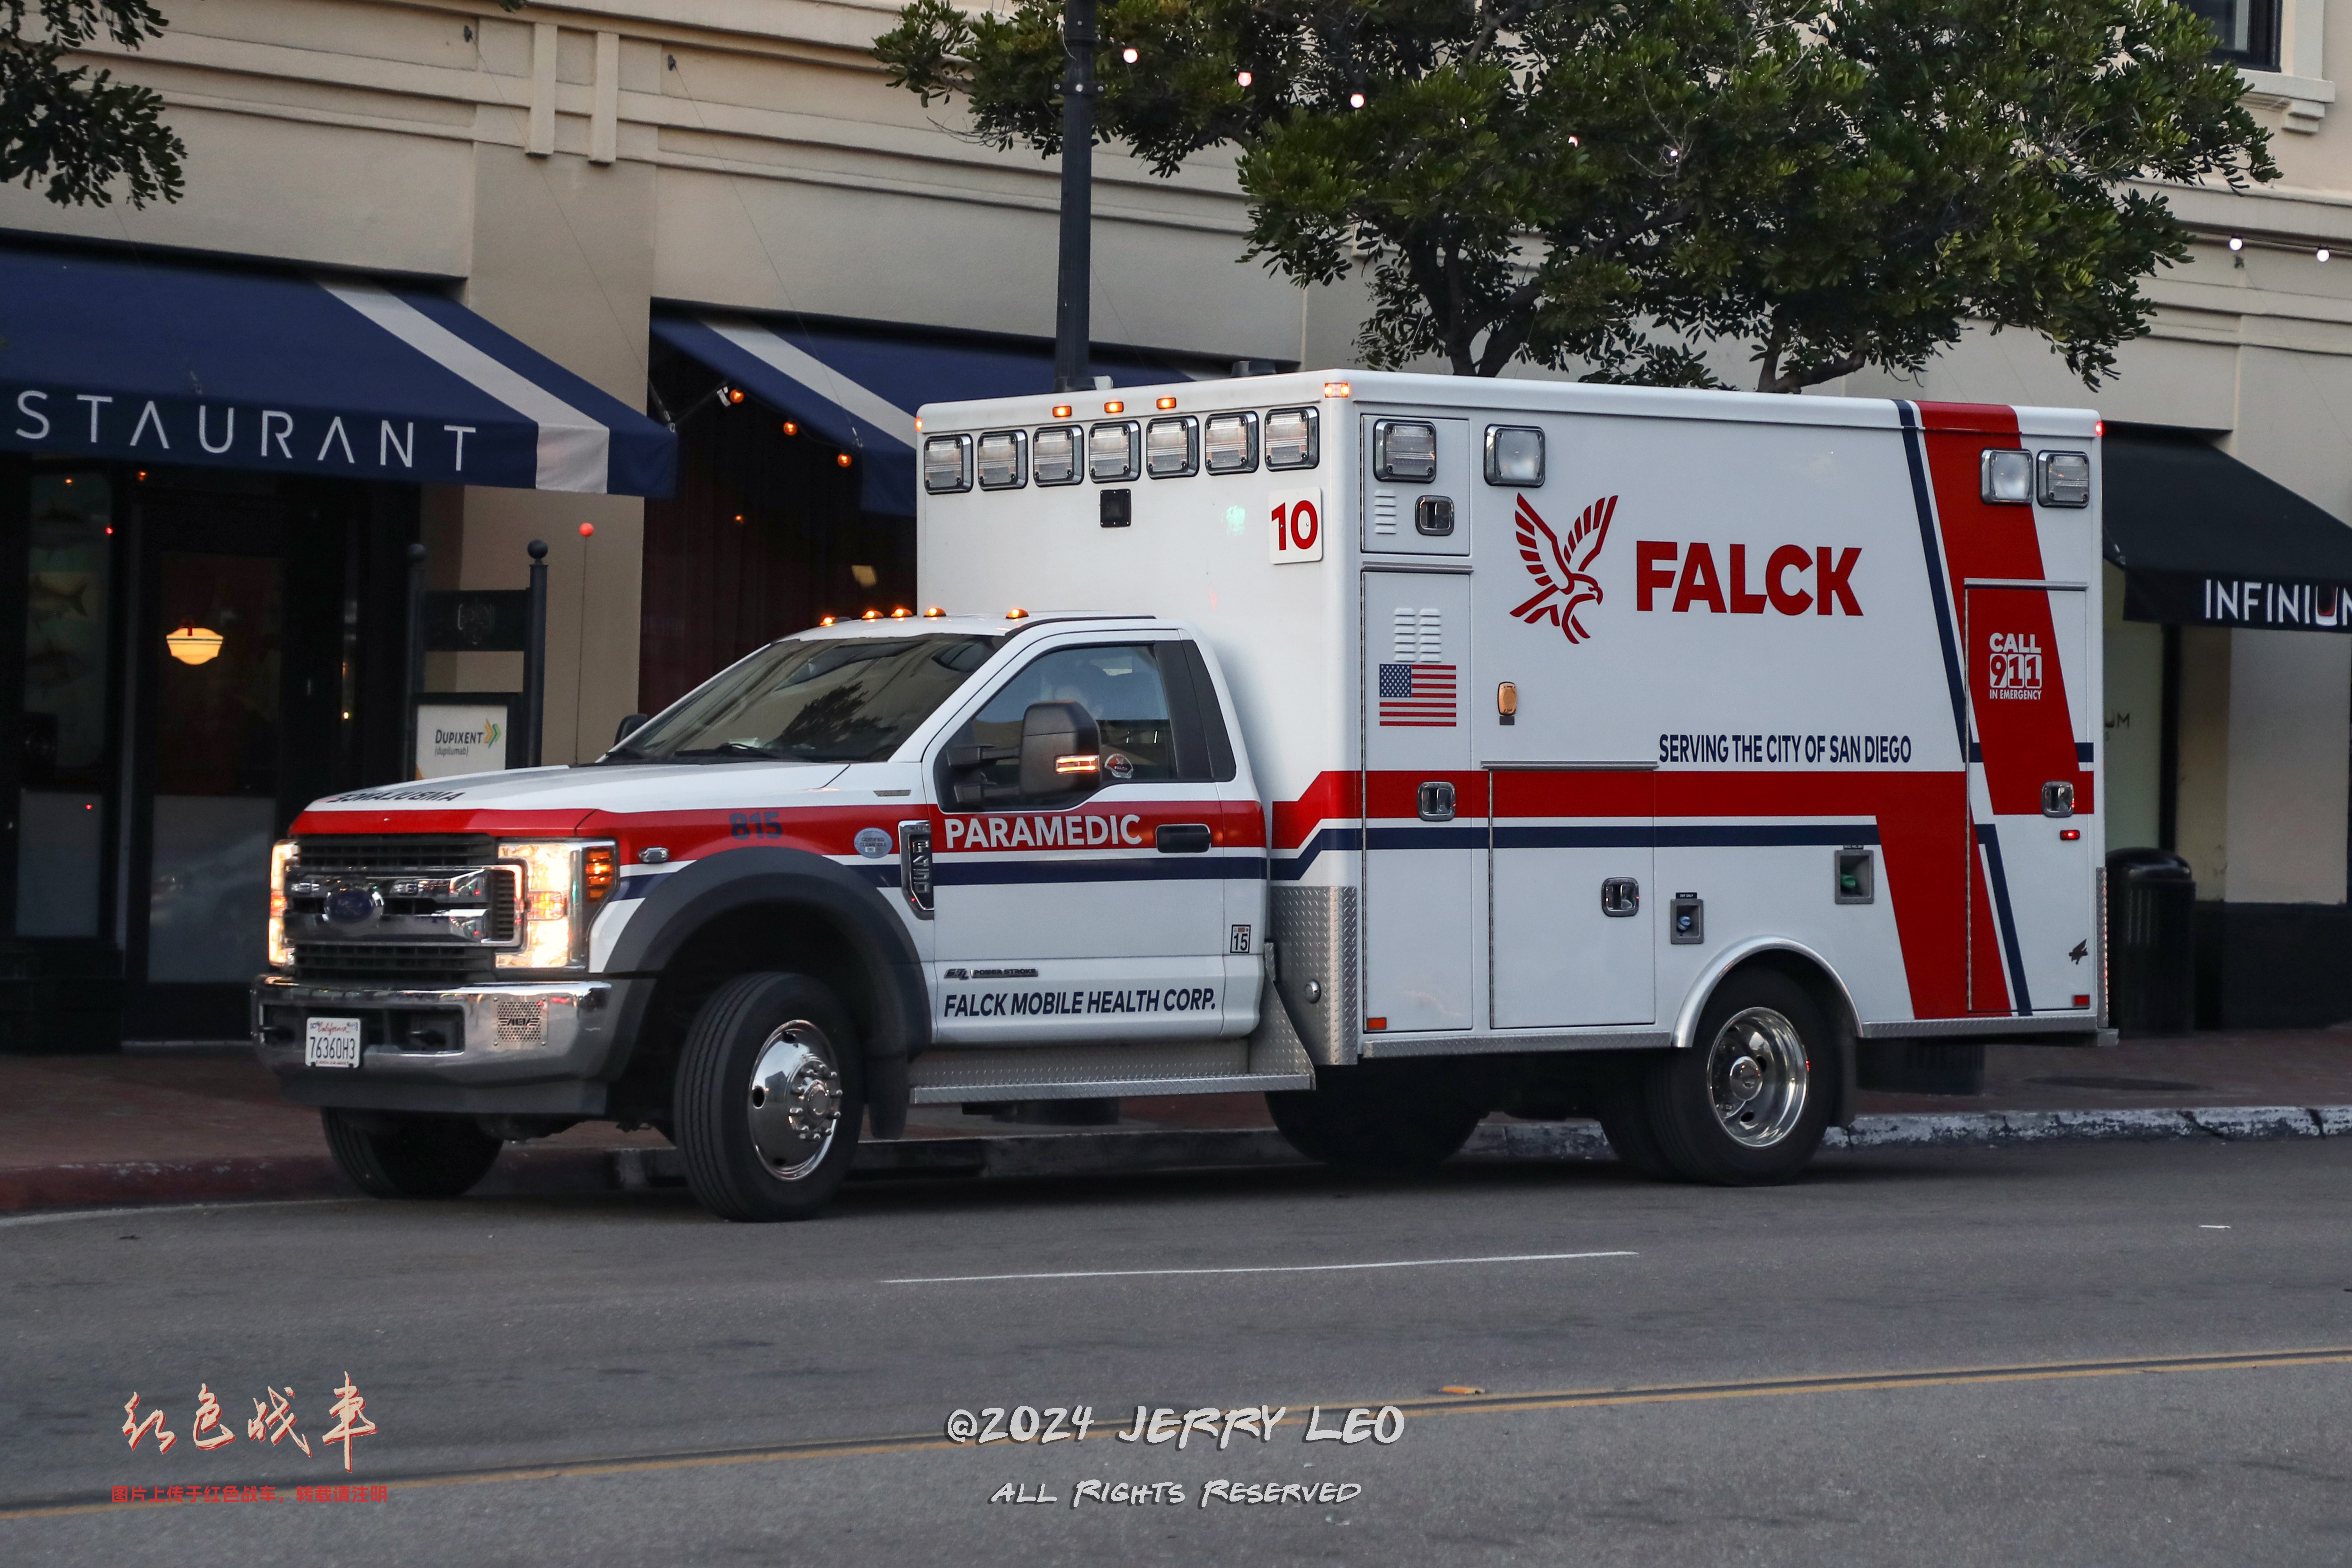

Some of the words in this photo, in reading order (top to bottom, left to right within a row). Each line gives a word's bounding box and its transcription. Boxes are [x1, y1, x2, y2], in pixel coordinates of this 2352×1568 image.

[1272, 499, 1318, 551] 10
[1636, 540, 1864, 616] FALCK
[2205, 579, 2352, 626] INFINIU
[1989, 632, 2042, 654] CALL
[1990, 654, 2042, 689] 911
[1990, 689, 1998, 699] IN
[2000, 689, 2042, 700] EMERGENCY
[1659, 734, 1729, 763] SERVING
[1733, 734, 1762, 762] THE
[1766, 735, 1802, 763] CITY
[1805, 735, 1826, 763] OF
[1830, 735, 1861, 763] SAN
[1865, 735, 1911, 763] DIEGO
[729, 811, 782, 840] 815
[944, 814, 1143, 849] PARAMEDIC
[1233, 933, 1248, 951] 15
[944, 993, 1008, 1017] FALCK
[1011, 991, 1084, 1015] MOBILE
[1087, 989, 1160, 1013] HEALTH
[1163, 988, 1216, 1011] CORP.
[310, 1037, 355, 1059] 76360H3
